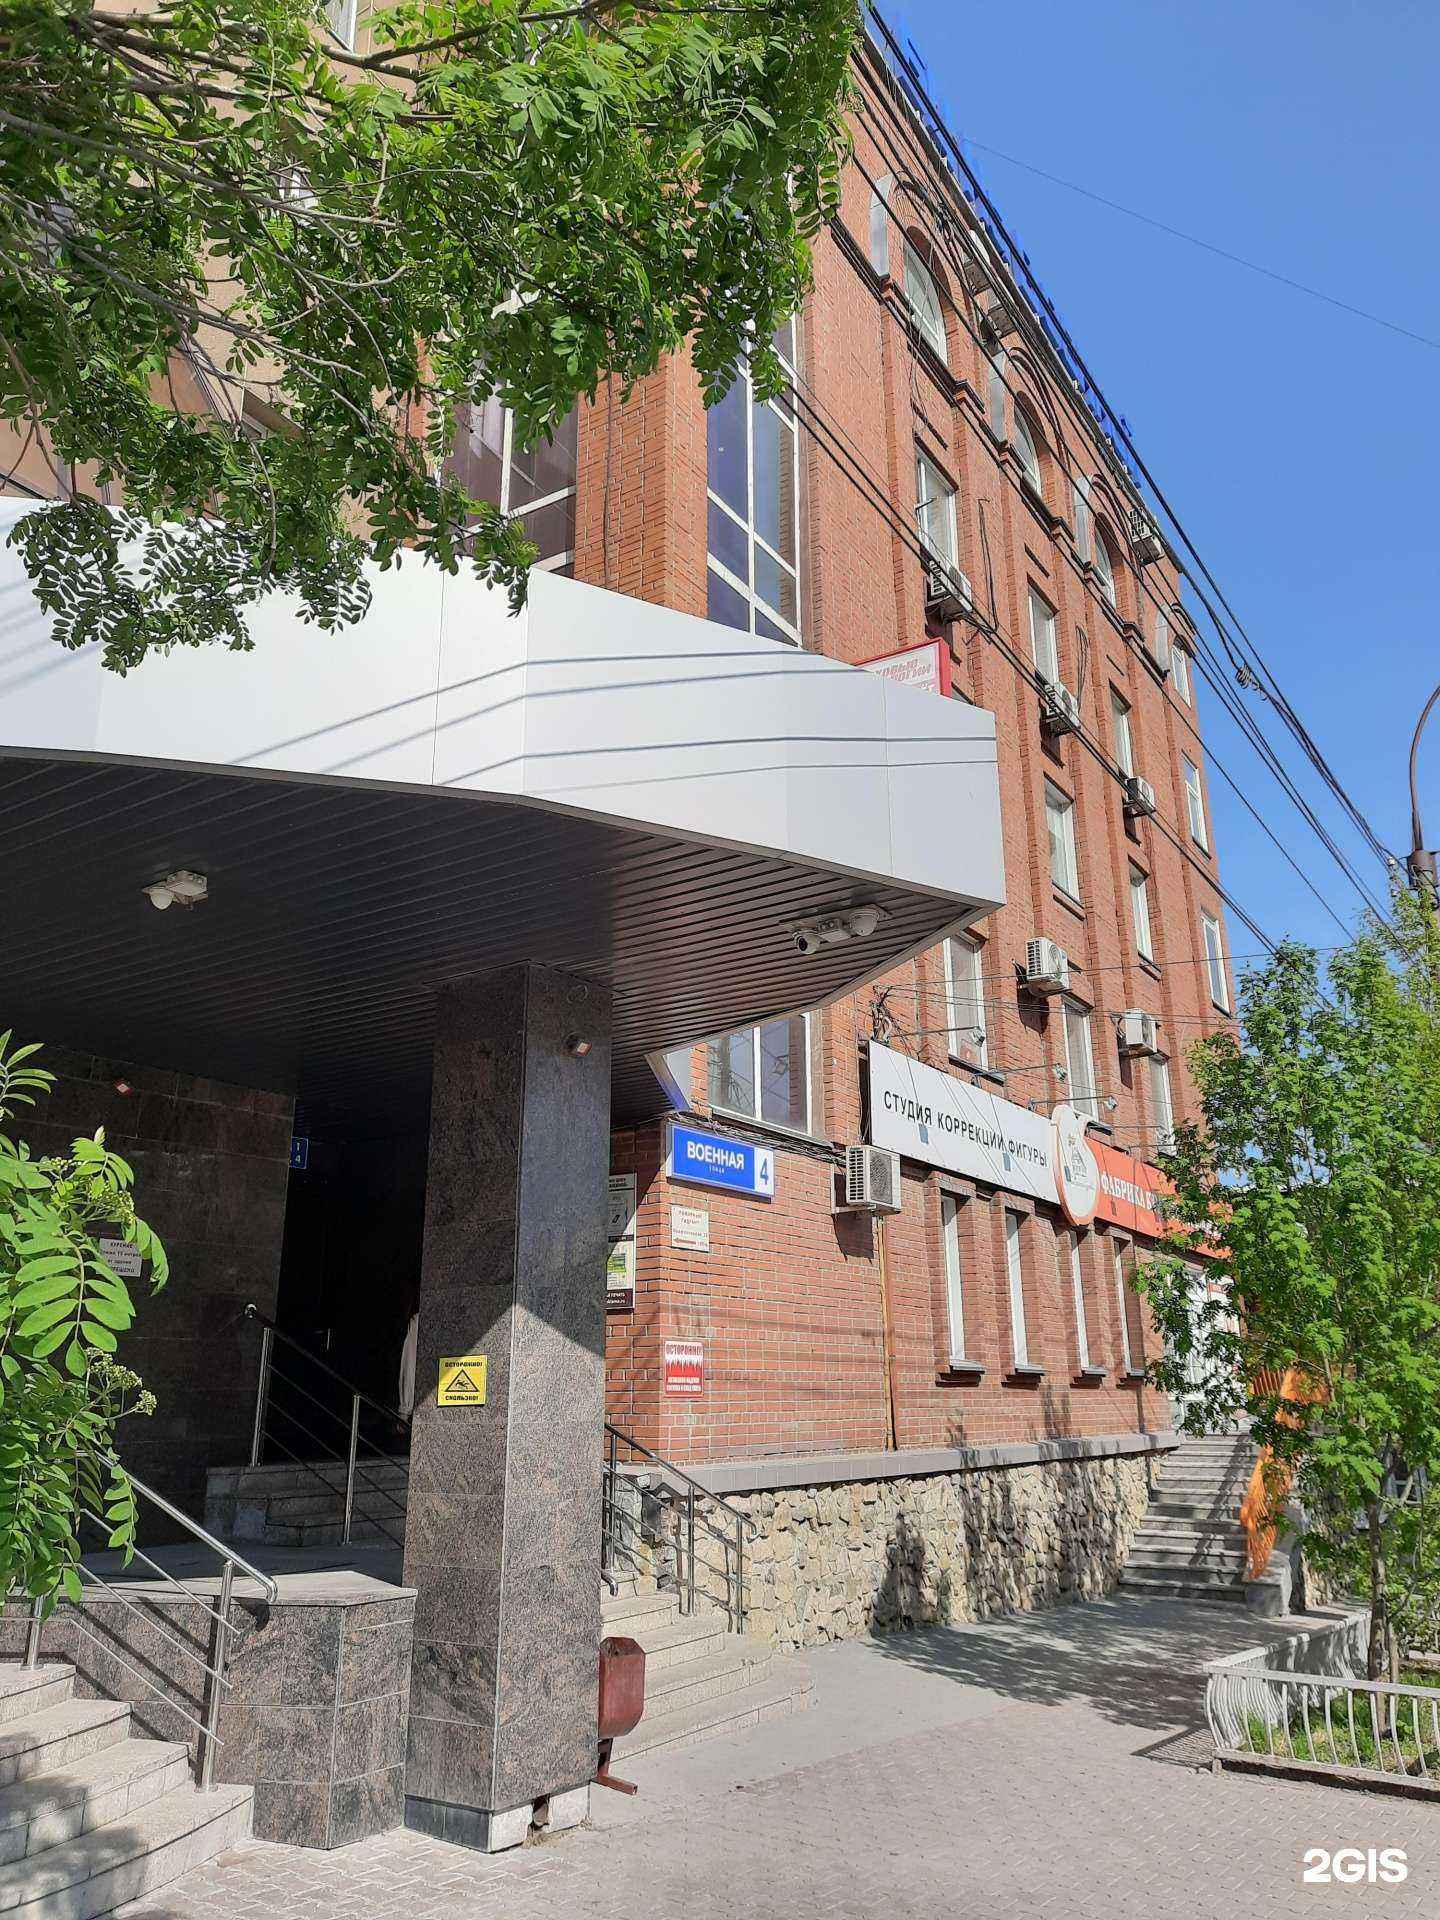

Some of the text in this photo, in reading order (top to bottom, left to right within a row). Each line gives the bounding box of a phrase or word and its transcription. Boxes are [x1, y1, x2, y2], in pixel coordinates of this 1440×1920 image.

[884, 1090, 1048, 1168] СТУДИЯ КОРРЕКЦИИ ФИГУРЫ
[686, 1140, 769, 1185] ВОЕННАЯ 4
[1101, 1171, 1145, 1208] ФАБРИКА
